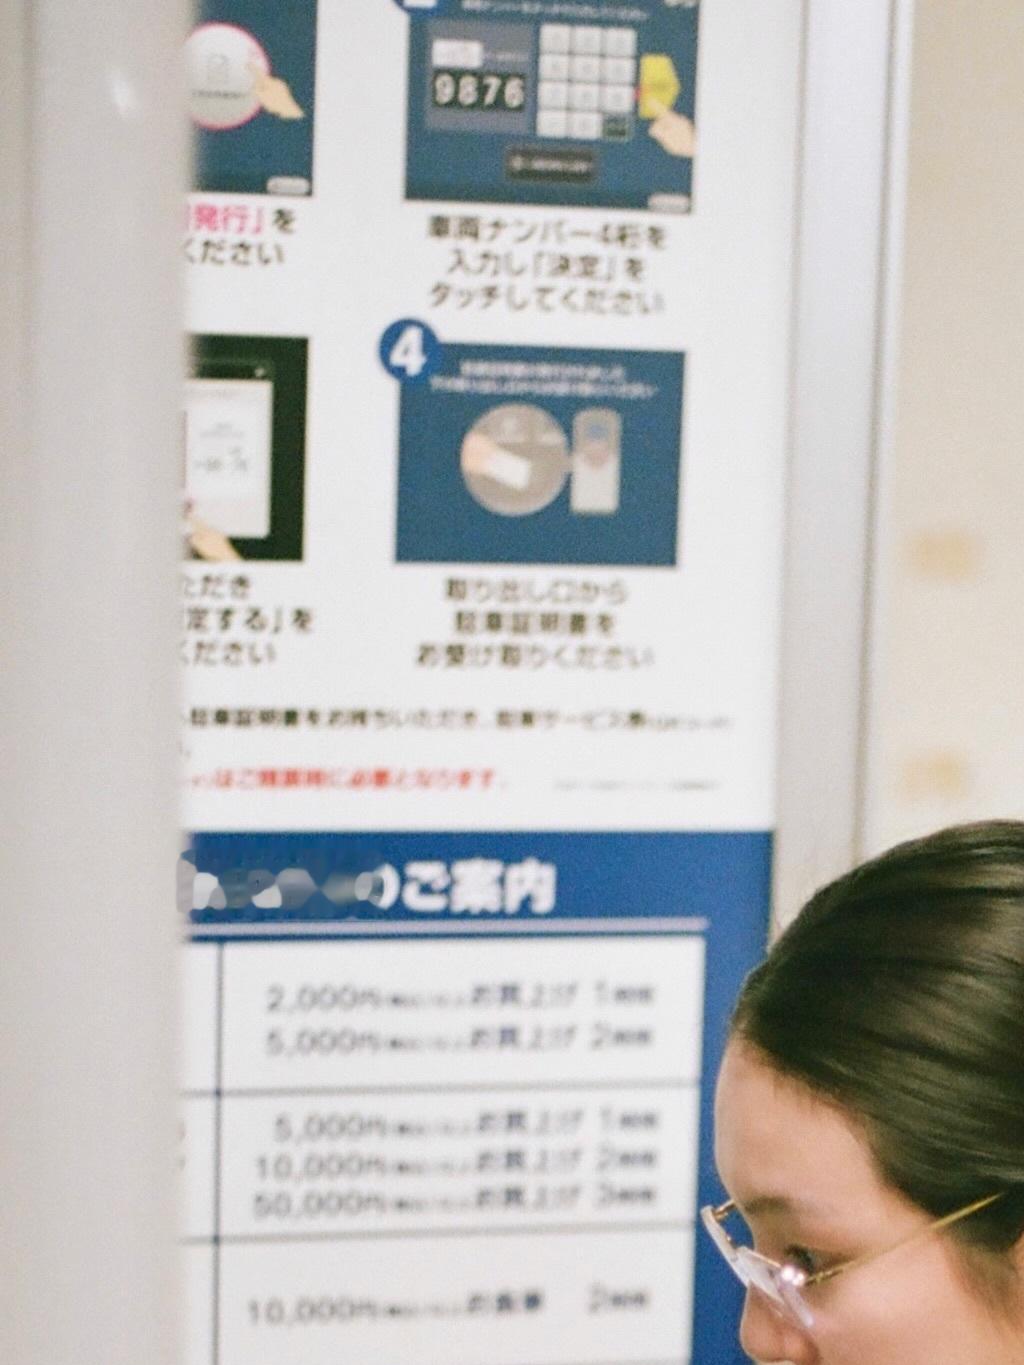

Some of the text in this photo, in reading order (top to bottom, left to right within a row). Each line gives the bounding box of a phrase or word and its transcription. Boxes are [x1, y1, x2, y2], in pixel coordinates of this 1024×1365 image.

[433, 72, 526, 108] 9876
[429, 214, 668, 249] 車両ナンバー4桁を
[447, 248, 646, 282] 入力し「決定」を
[429, 281, 664, 315] タッチしてください
[391, 325, 426, 376] 4
